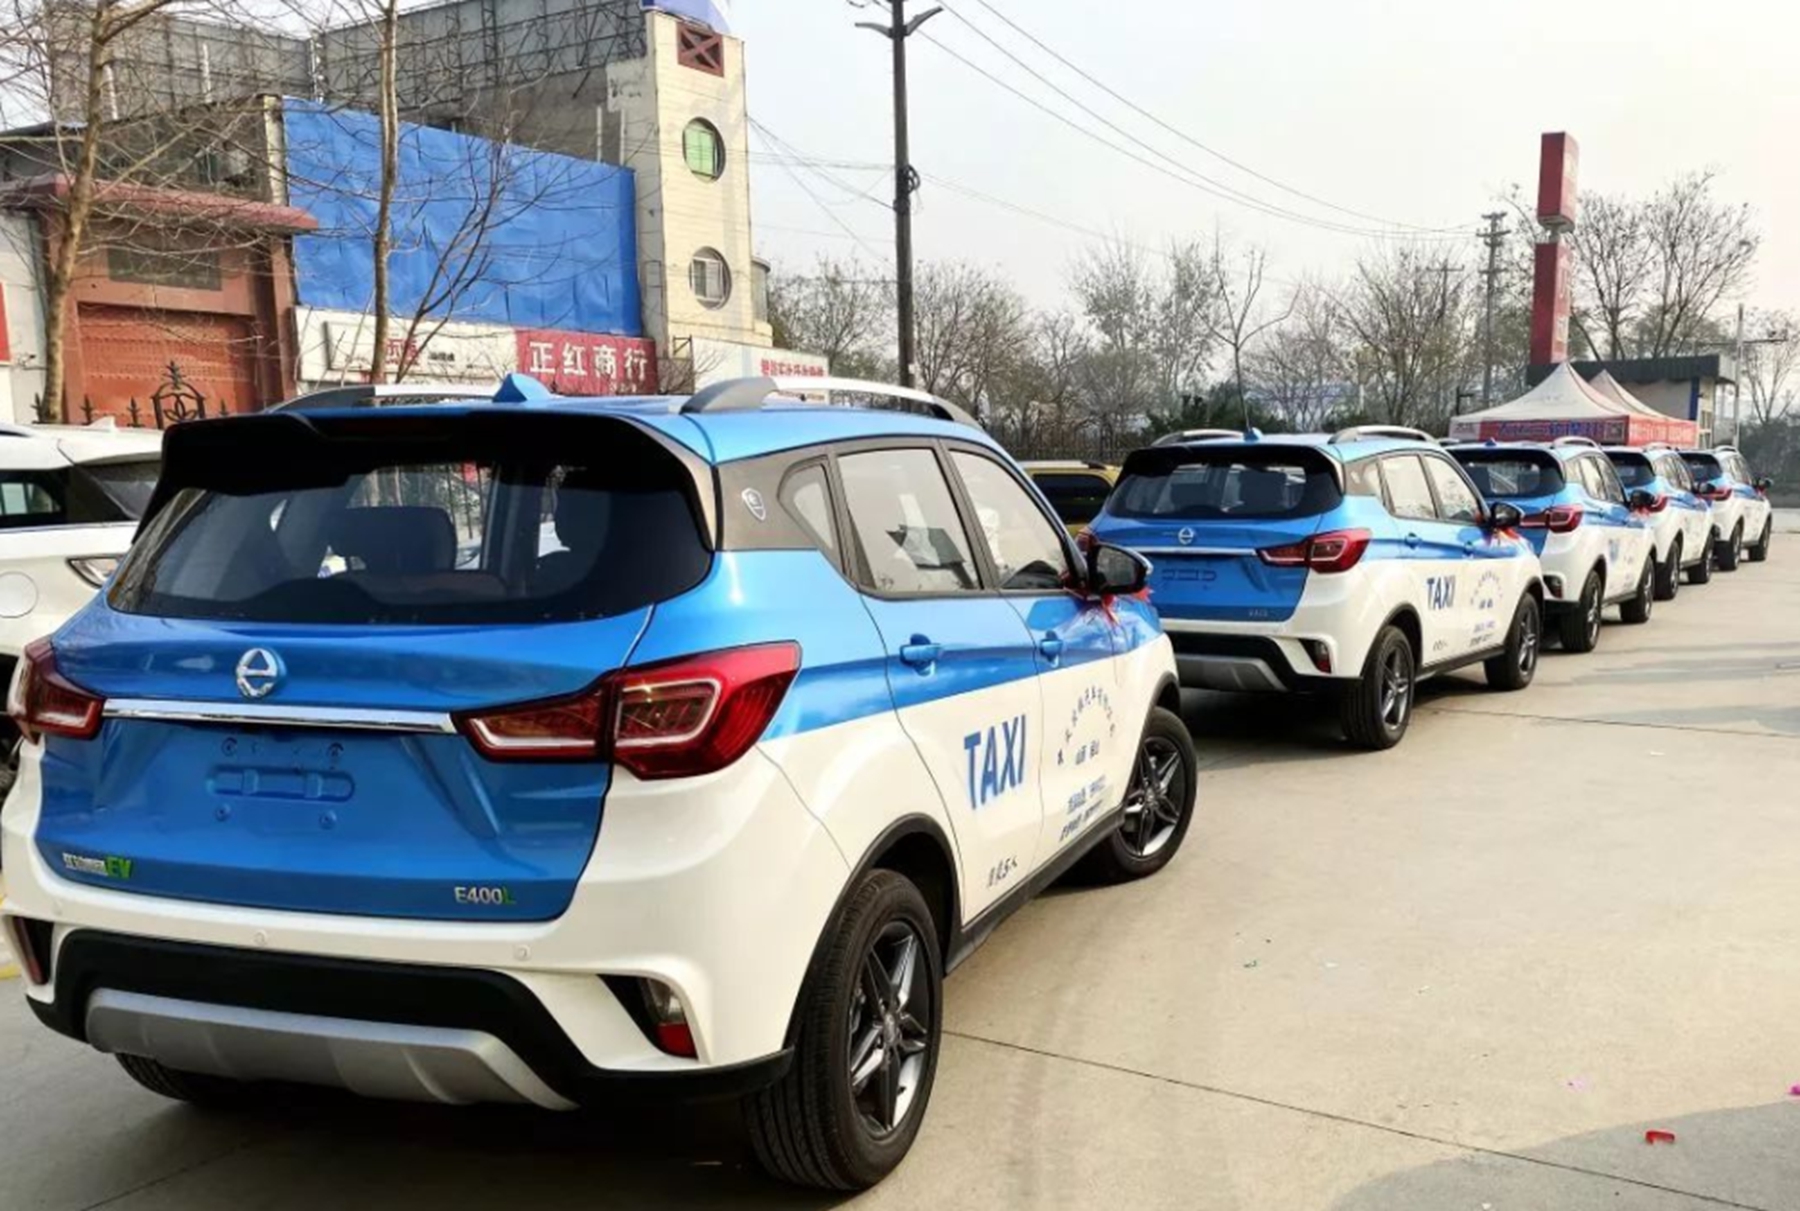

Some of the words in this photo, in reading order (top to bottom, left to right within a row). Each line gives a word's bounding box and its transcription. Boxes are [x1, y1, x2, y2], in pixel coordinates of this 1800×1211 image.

[529, 341, 648, 381] 正红商行
[1426, 576, 1456, 610] TAXI
[964, 714, 1026, 810] TAXI
[454, 886, 516, 905] E400L
